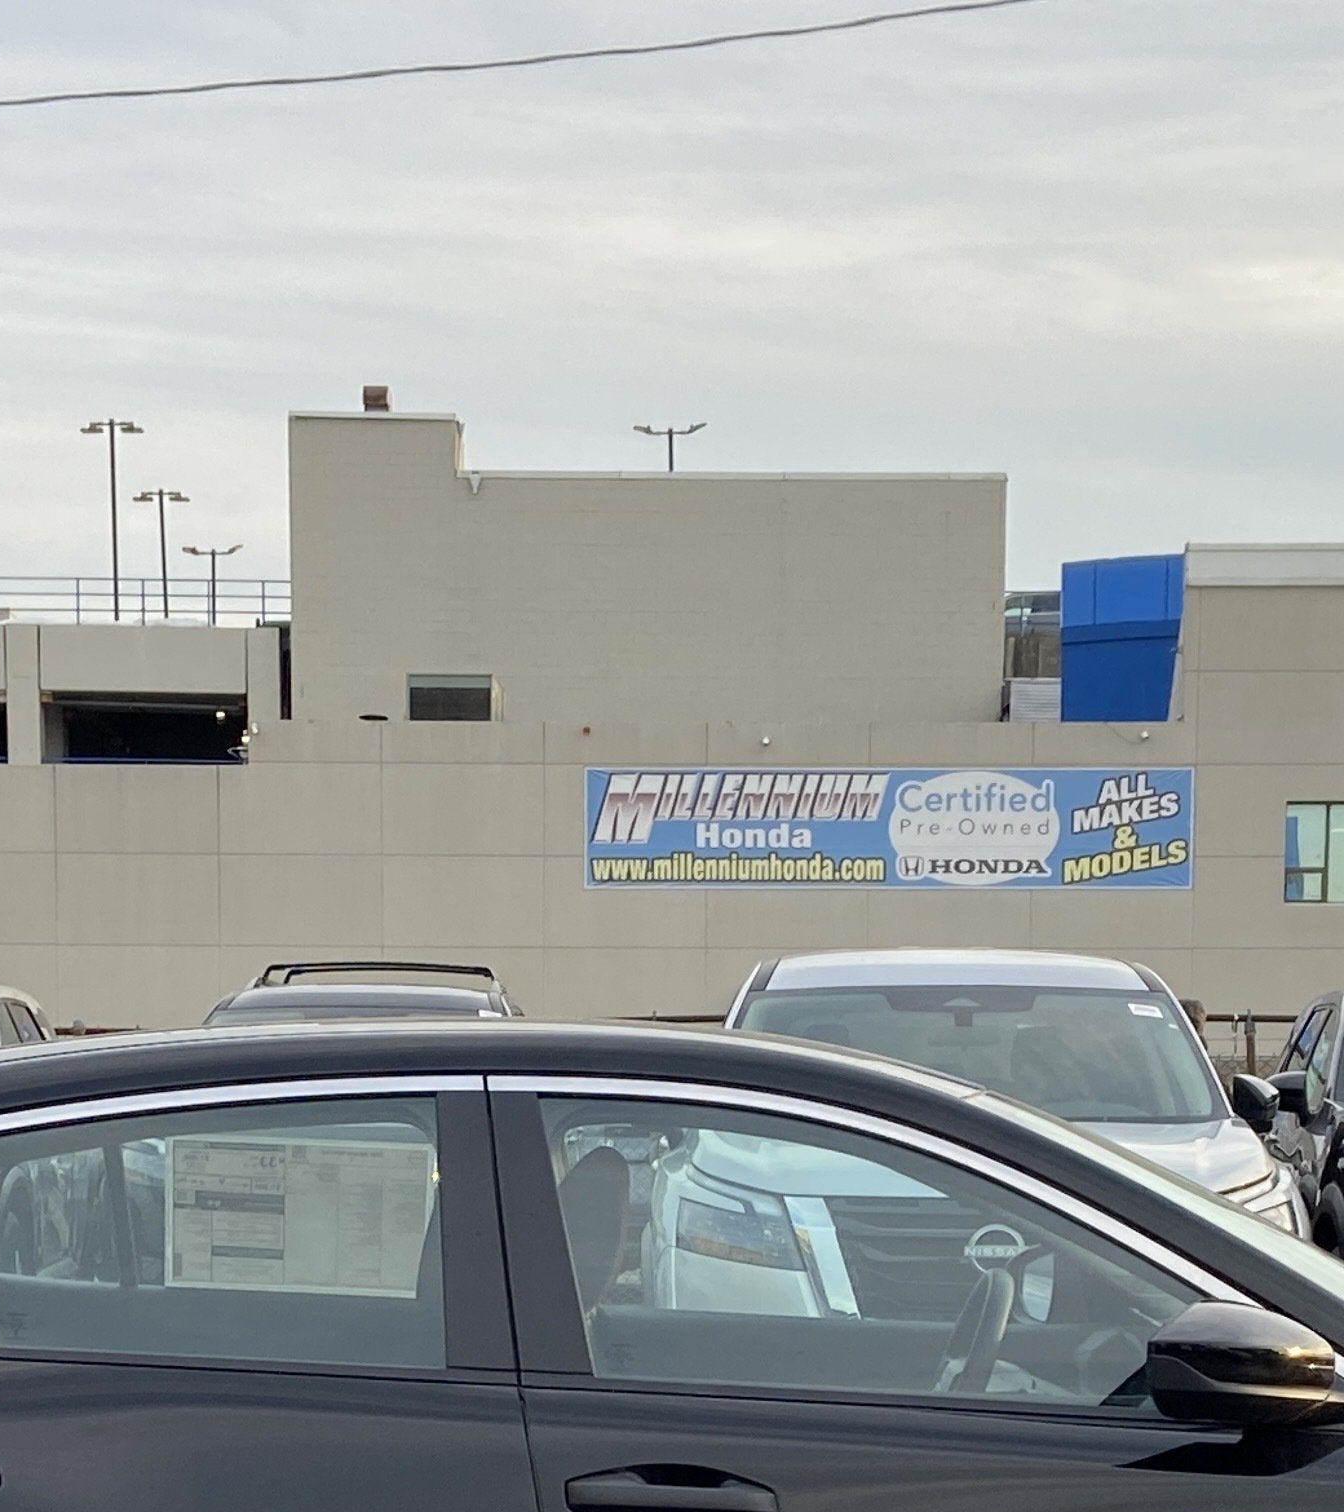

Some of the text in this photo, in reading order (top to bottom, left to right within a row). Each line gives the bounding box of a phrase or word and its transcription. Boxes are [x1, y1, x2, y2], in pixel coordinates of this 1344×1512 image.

[899, 781, 1051, 814] Certified
[1098, 773, 1155, 804] ALL
[590, 772, 891, 845] MILLENNIUM
[1072, 793, 1181, 835] MAKES
[695, 822, 813, 849] Honda
[900, 818, 1051, 836] Pre-Owned
[1112, 824, 1139, 850] &
[591, 852, 886, 881] www.millenniumhonda.com
[928, 858, 1048, 875] HONDA
[1062, 839, 1189, 885] MODELS
